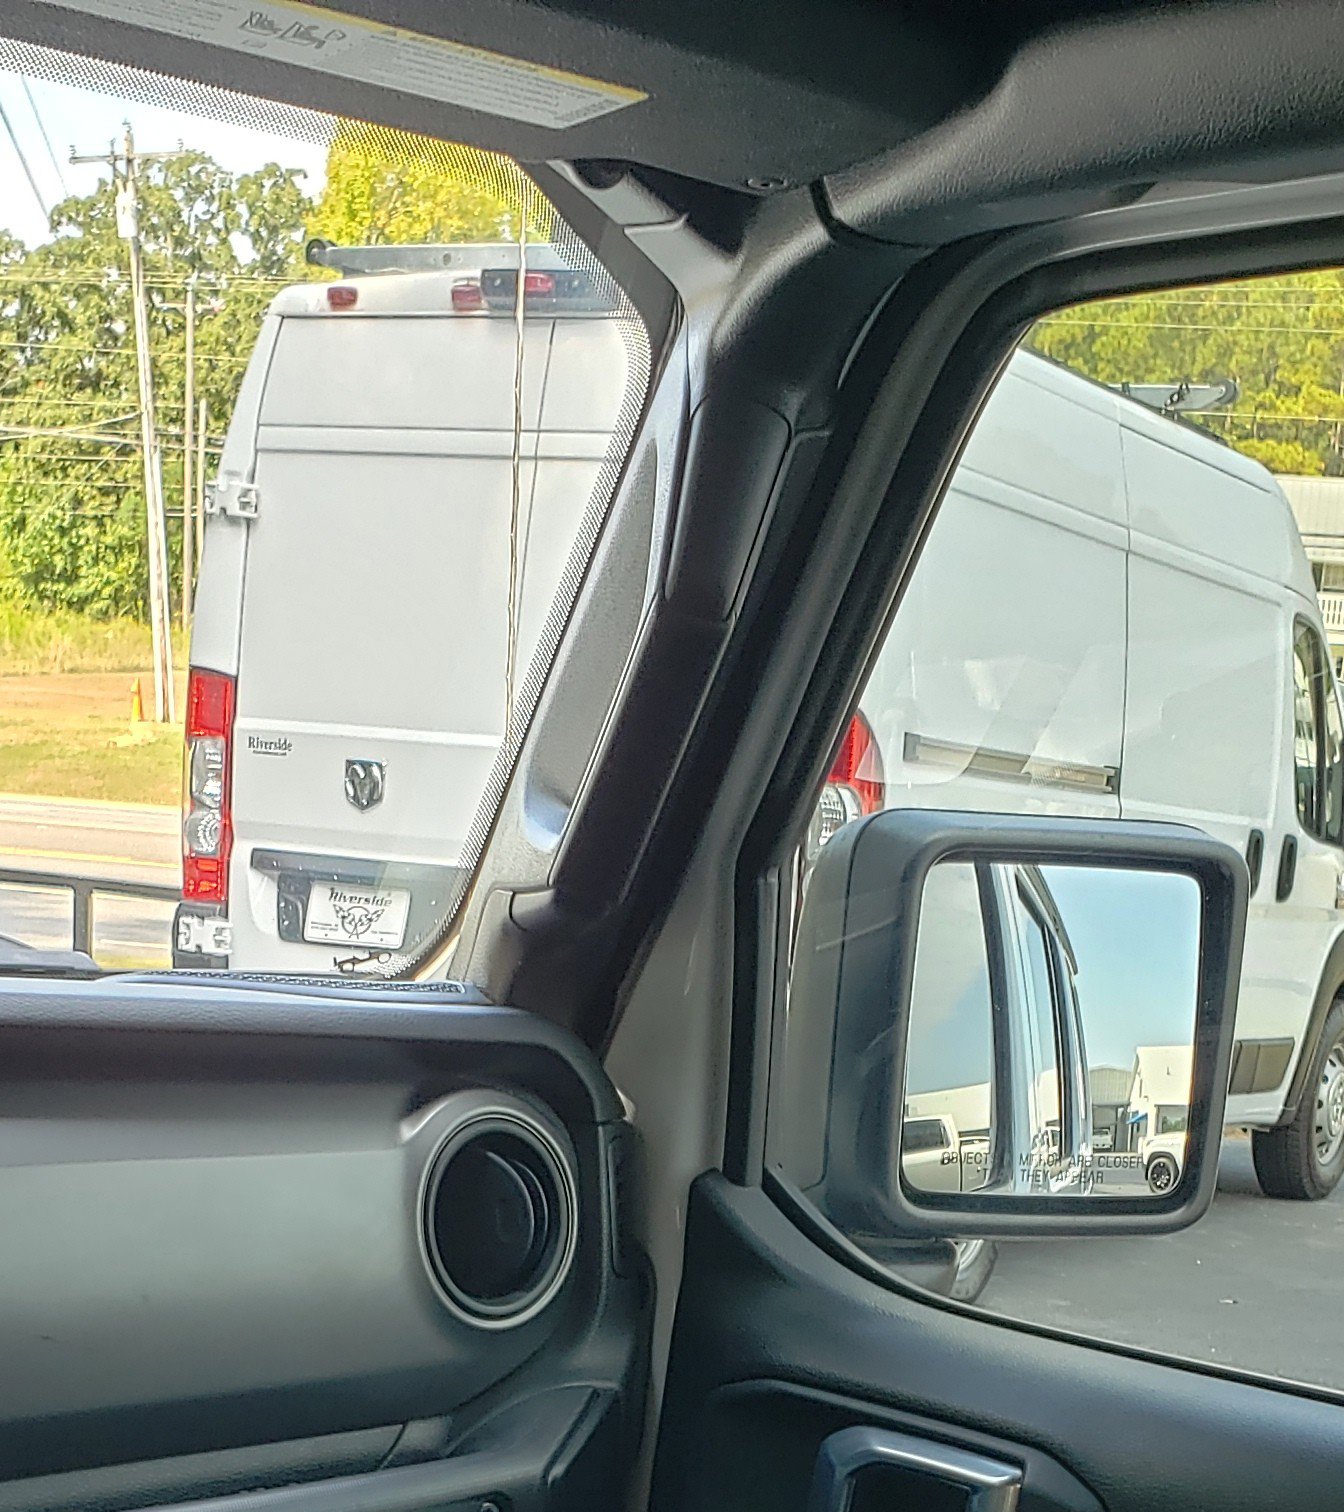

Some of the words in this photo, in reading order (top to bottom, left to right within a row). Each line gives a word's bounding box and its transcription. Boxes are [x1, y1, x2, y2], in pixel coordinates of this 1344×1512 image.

[248, 736, 293, 752] Riverside
[328, 887, 393, 907] Riverside
[941, 1152, 992, 1166] OBJECT
[1069, 1154, 1094, 1168] ARE
[1098, 1155, 1144, 1169] CLOSER
[1020, 1169, 1050, 1183] THEY
